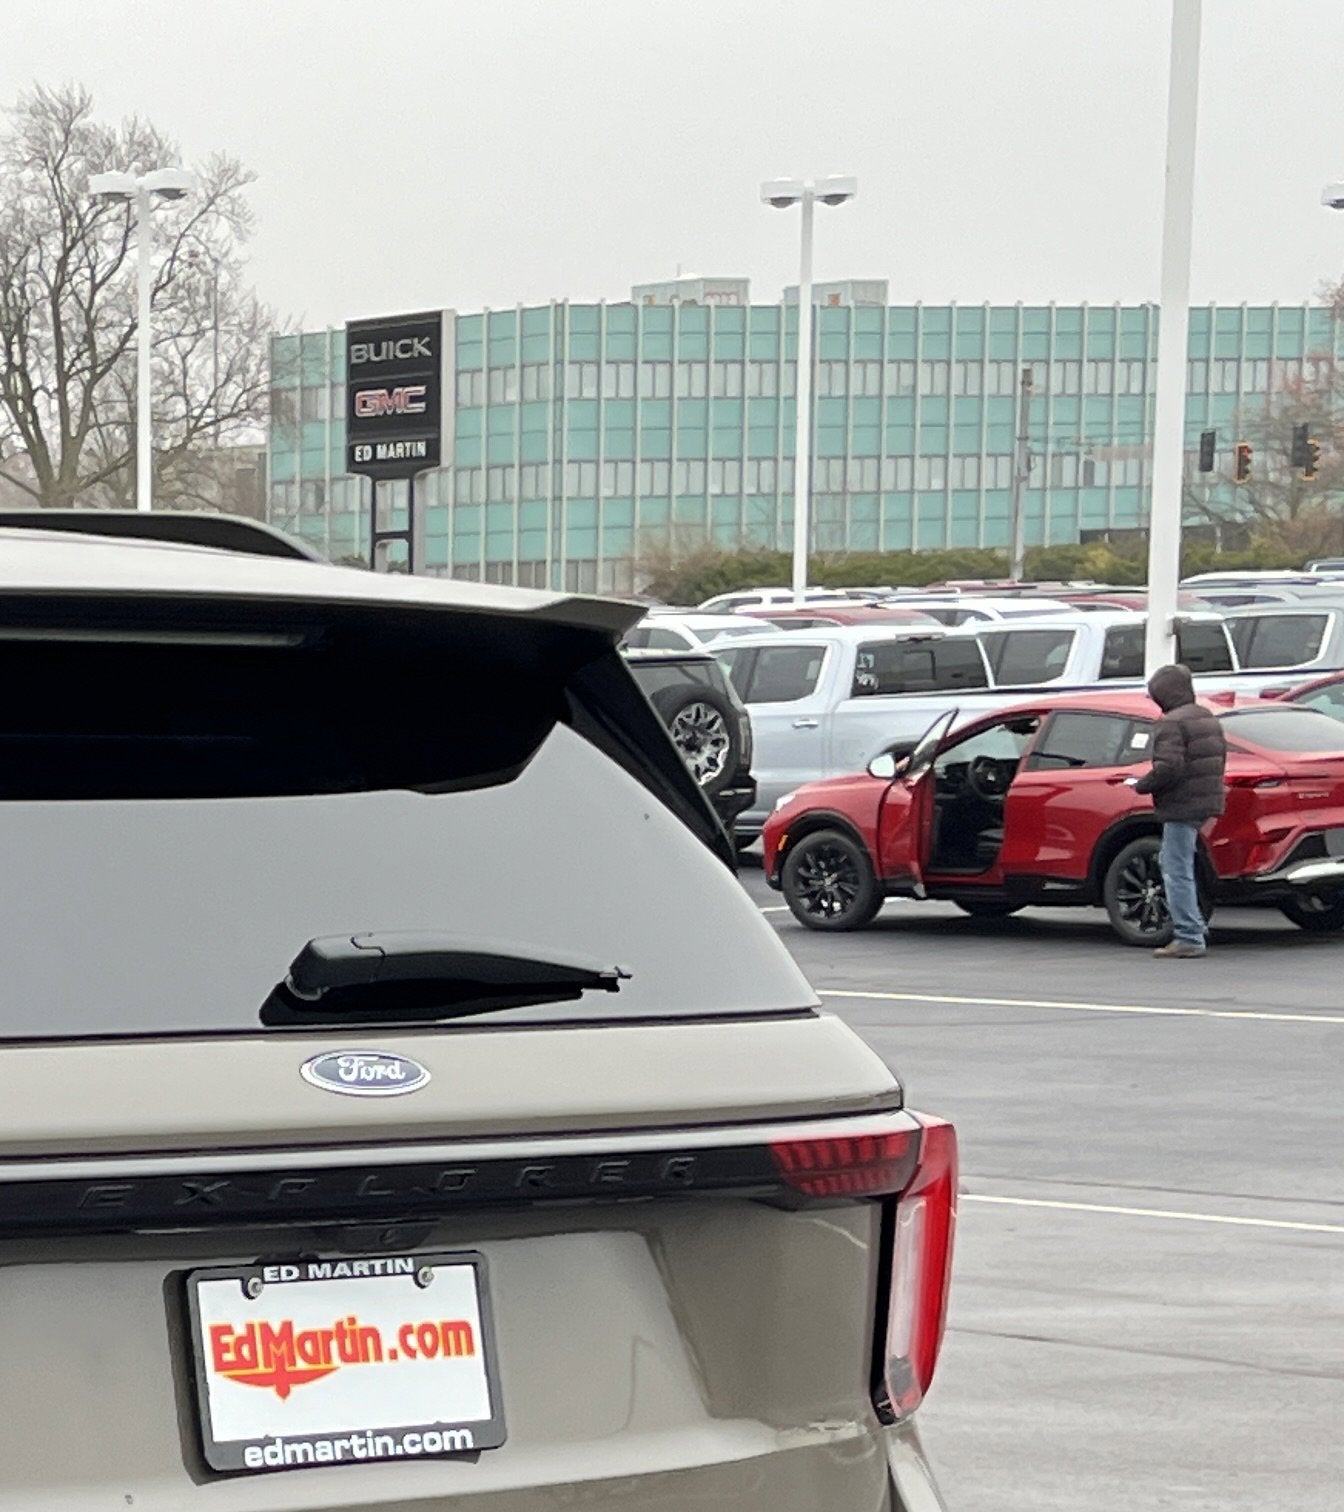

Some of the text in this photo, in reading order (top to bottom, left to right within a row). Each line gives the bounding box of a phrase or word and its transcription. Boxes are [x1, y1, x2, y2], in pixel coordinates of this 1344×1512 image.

[350, 336, 432, 364] BUICK
[355, 385, 427, 417] GMC
[354, 441, 427, 462] ED MARTIN
[337, 1055, 406, 1082] Ford
[77, 1157, 698, 1209] EXPLORER
[263, 1257, 416, 1282] ED MARTIN
[243, 1427, 475, 1468] edmartin.com
